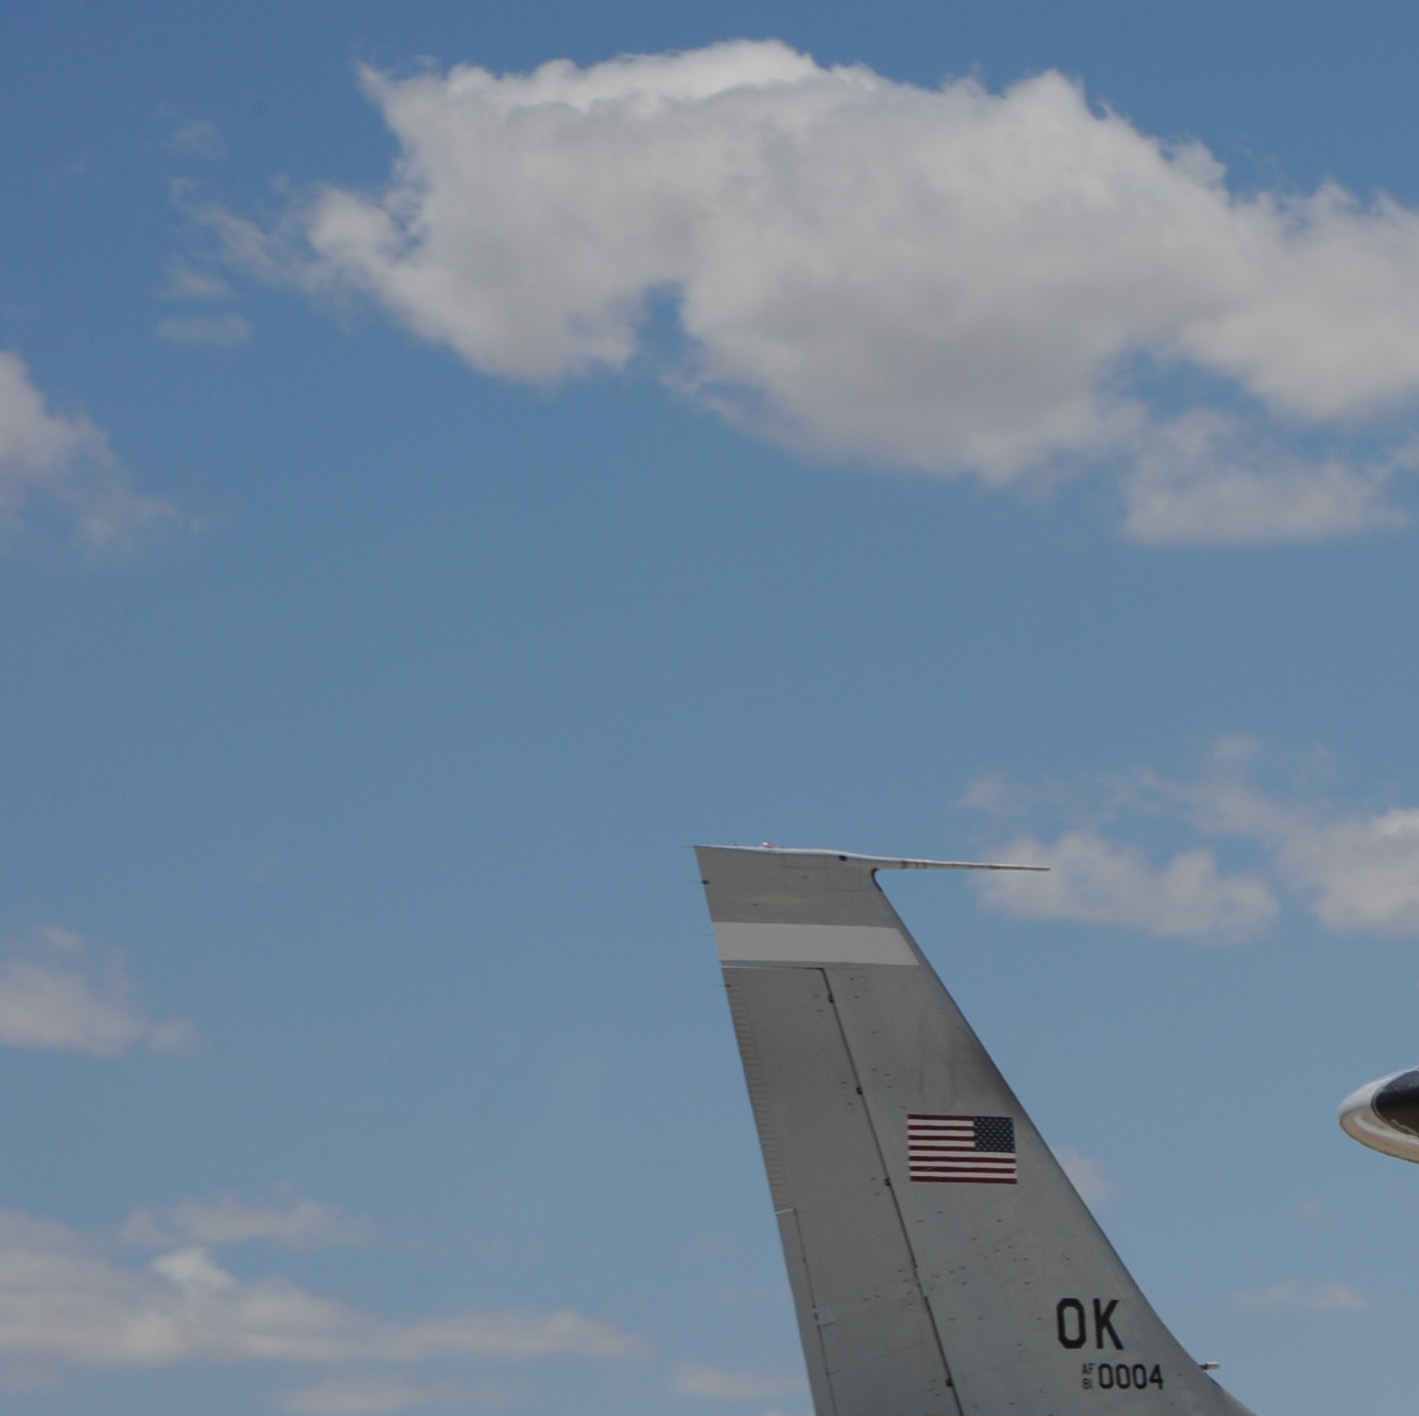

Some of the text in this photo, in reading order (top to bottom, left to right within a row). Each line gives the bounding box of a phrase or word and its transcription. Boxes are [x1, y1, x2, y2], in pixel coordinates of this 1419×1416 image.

[1056, 1297, 1124, 1350] OK
[1082, 1362, 1096, 1375] AF
[1098, 1362, 1164, 1390] 0004
